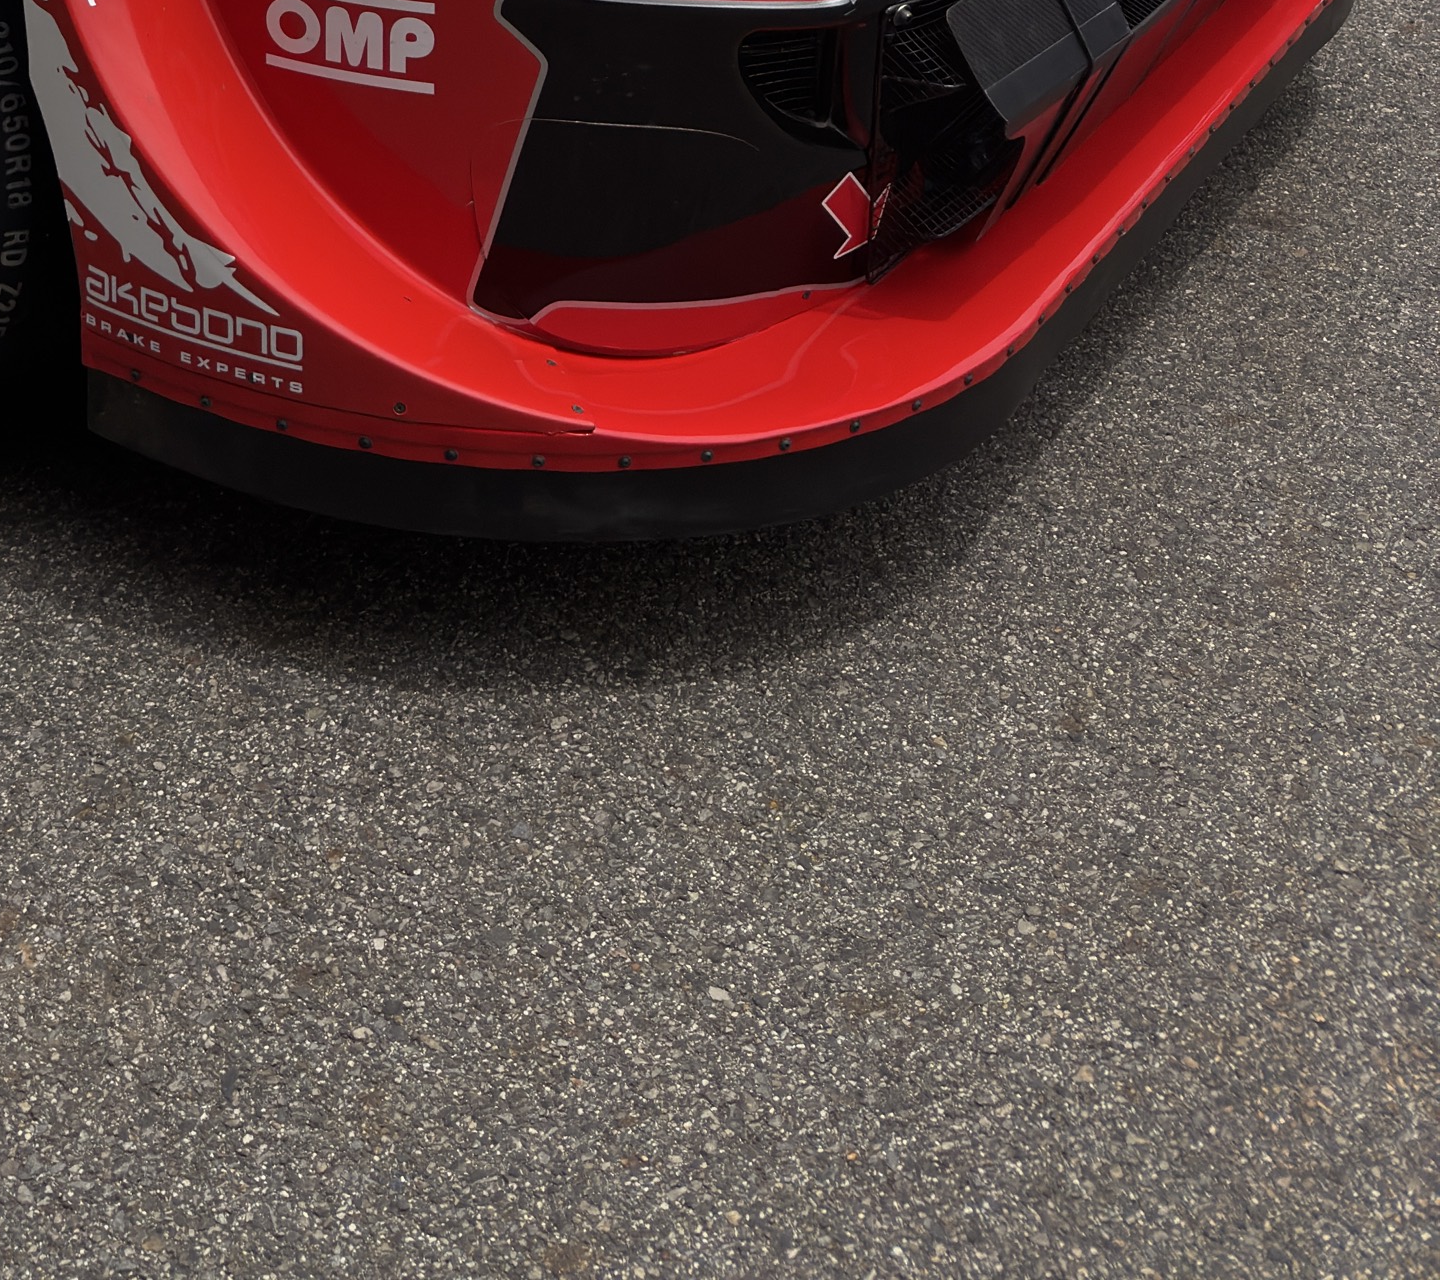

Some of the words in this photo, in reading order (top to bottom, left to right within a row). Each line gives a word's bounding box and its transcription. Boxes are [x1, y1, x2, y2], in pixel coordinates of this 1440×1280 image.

[0, 229, 48, 268] RD
[84, 312, 162, 353] BRAKE
[180, 351, 304, 394] EXPERTS
[85, 264, 303, 363] akebono
